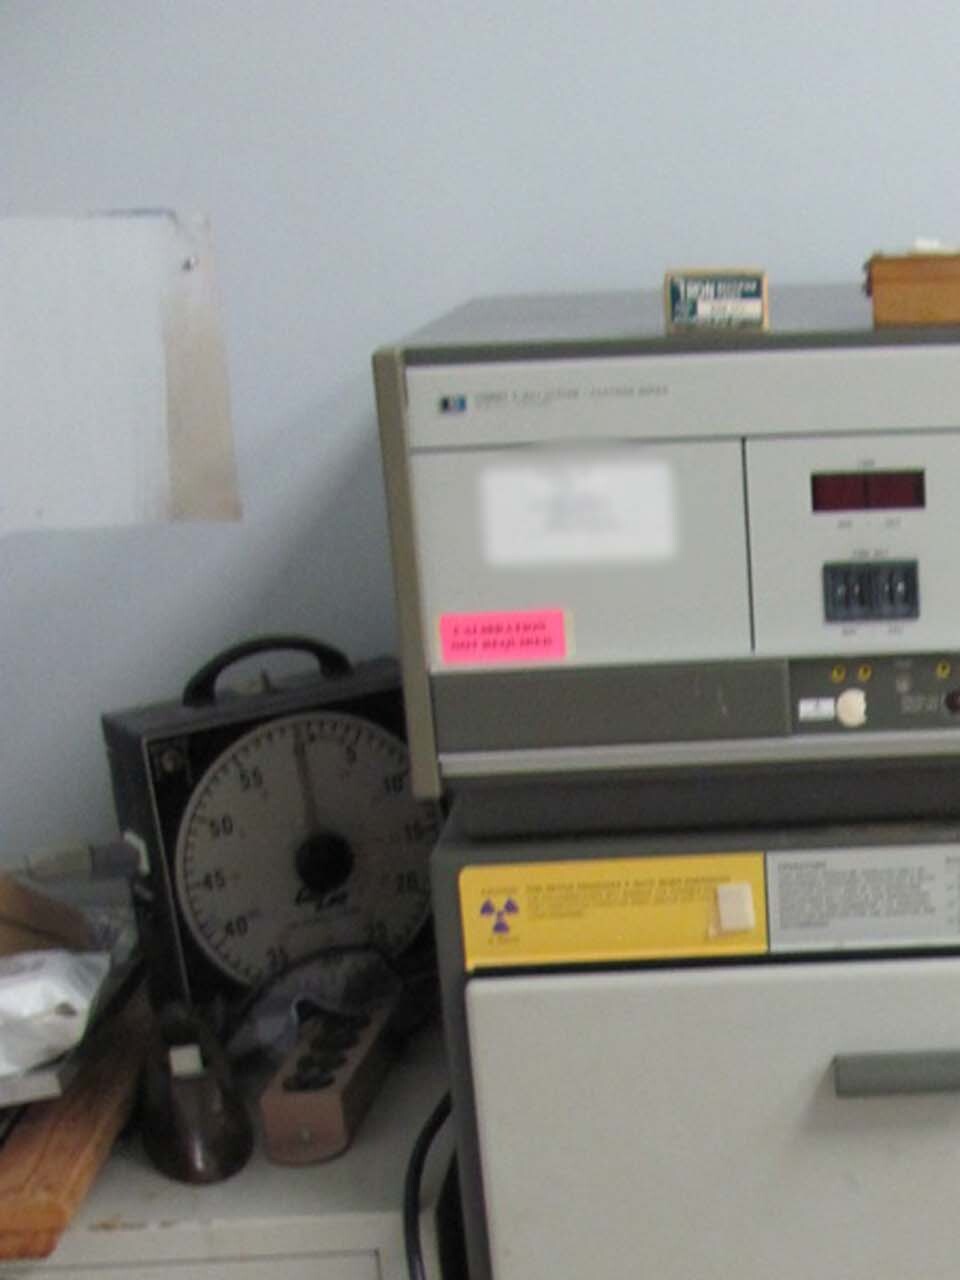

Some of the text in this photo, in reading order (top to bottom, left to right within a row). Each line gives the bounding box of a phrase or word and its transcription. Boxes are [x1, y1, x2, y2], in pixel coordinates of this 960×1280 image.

[208, 814, 234, 839] 50
[204, 869, 226, 891] 45
[224, 915, 249, 938] 40
